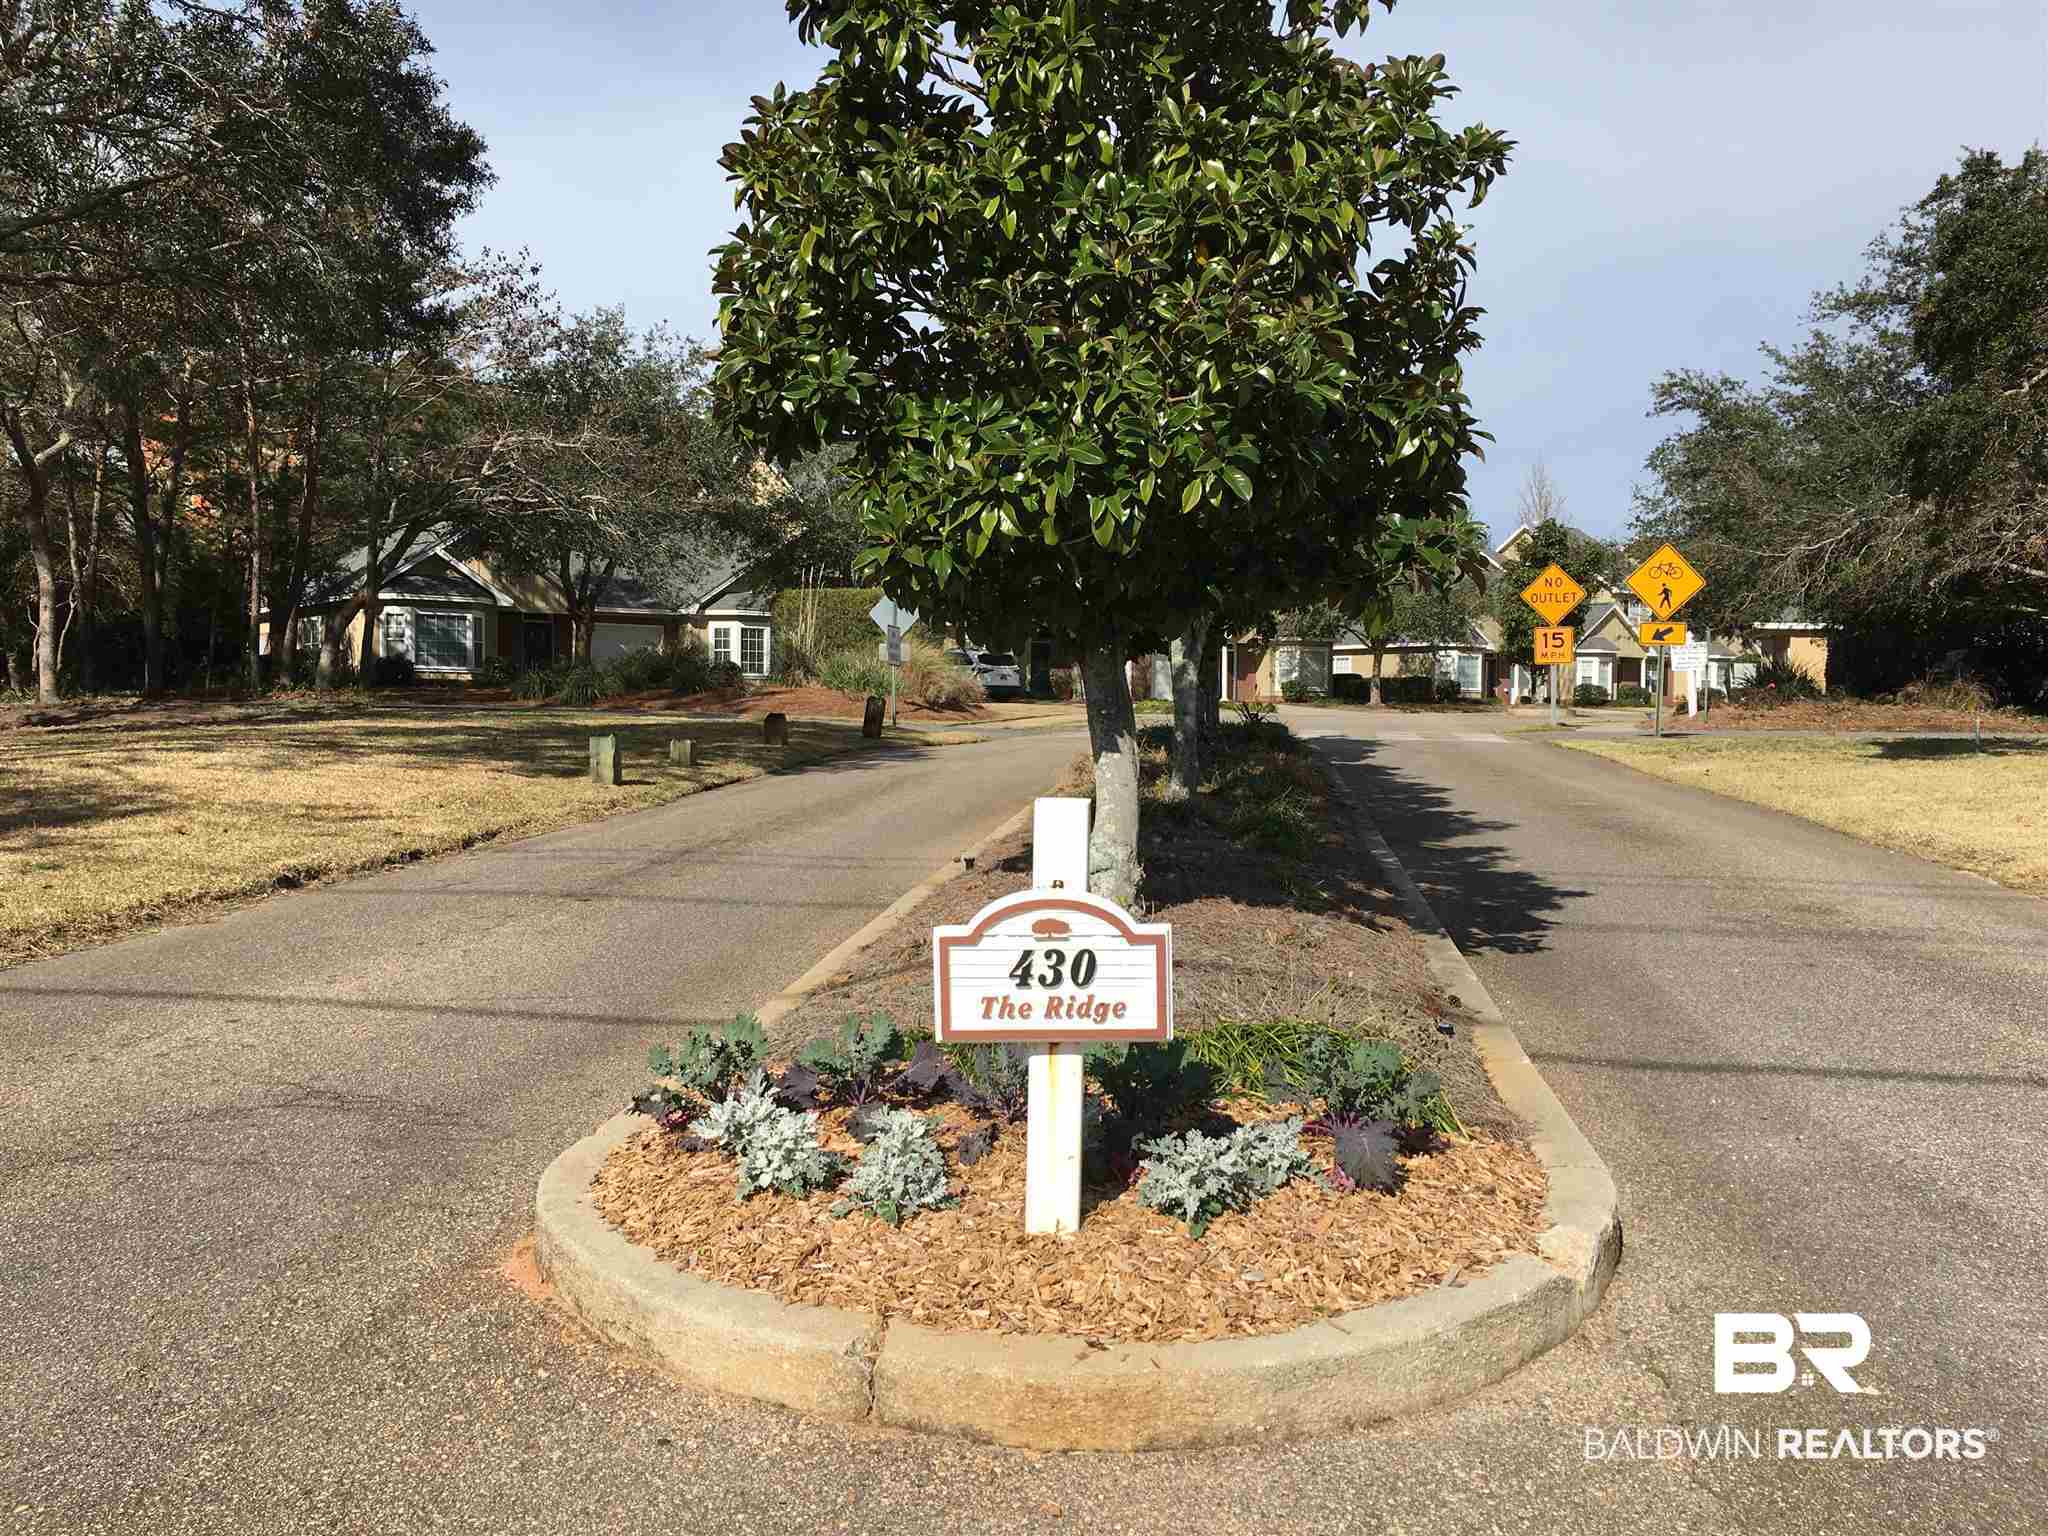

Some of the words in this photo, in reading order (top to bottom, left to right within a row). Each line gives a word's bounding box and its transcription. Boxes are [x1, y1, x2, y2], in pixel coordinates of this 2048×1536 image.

[1544, 577, 1563, 588] NO
[1530, 592, 1578, 604] OUTLET
[1542, 632, 1565, 649] 15
[1009, 949, 1097, 989] 430
[981, 996, 1033, 1020] The
[1043, 995, 1128, 1024] Ridge
